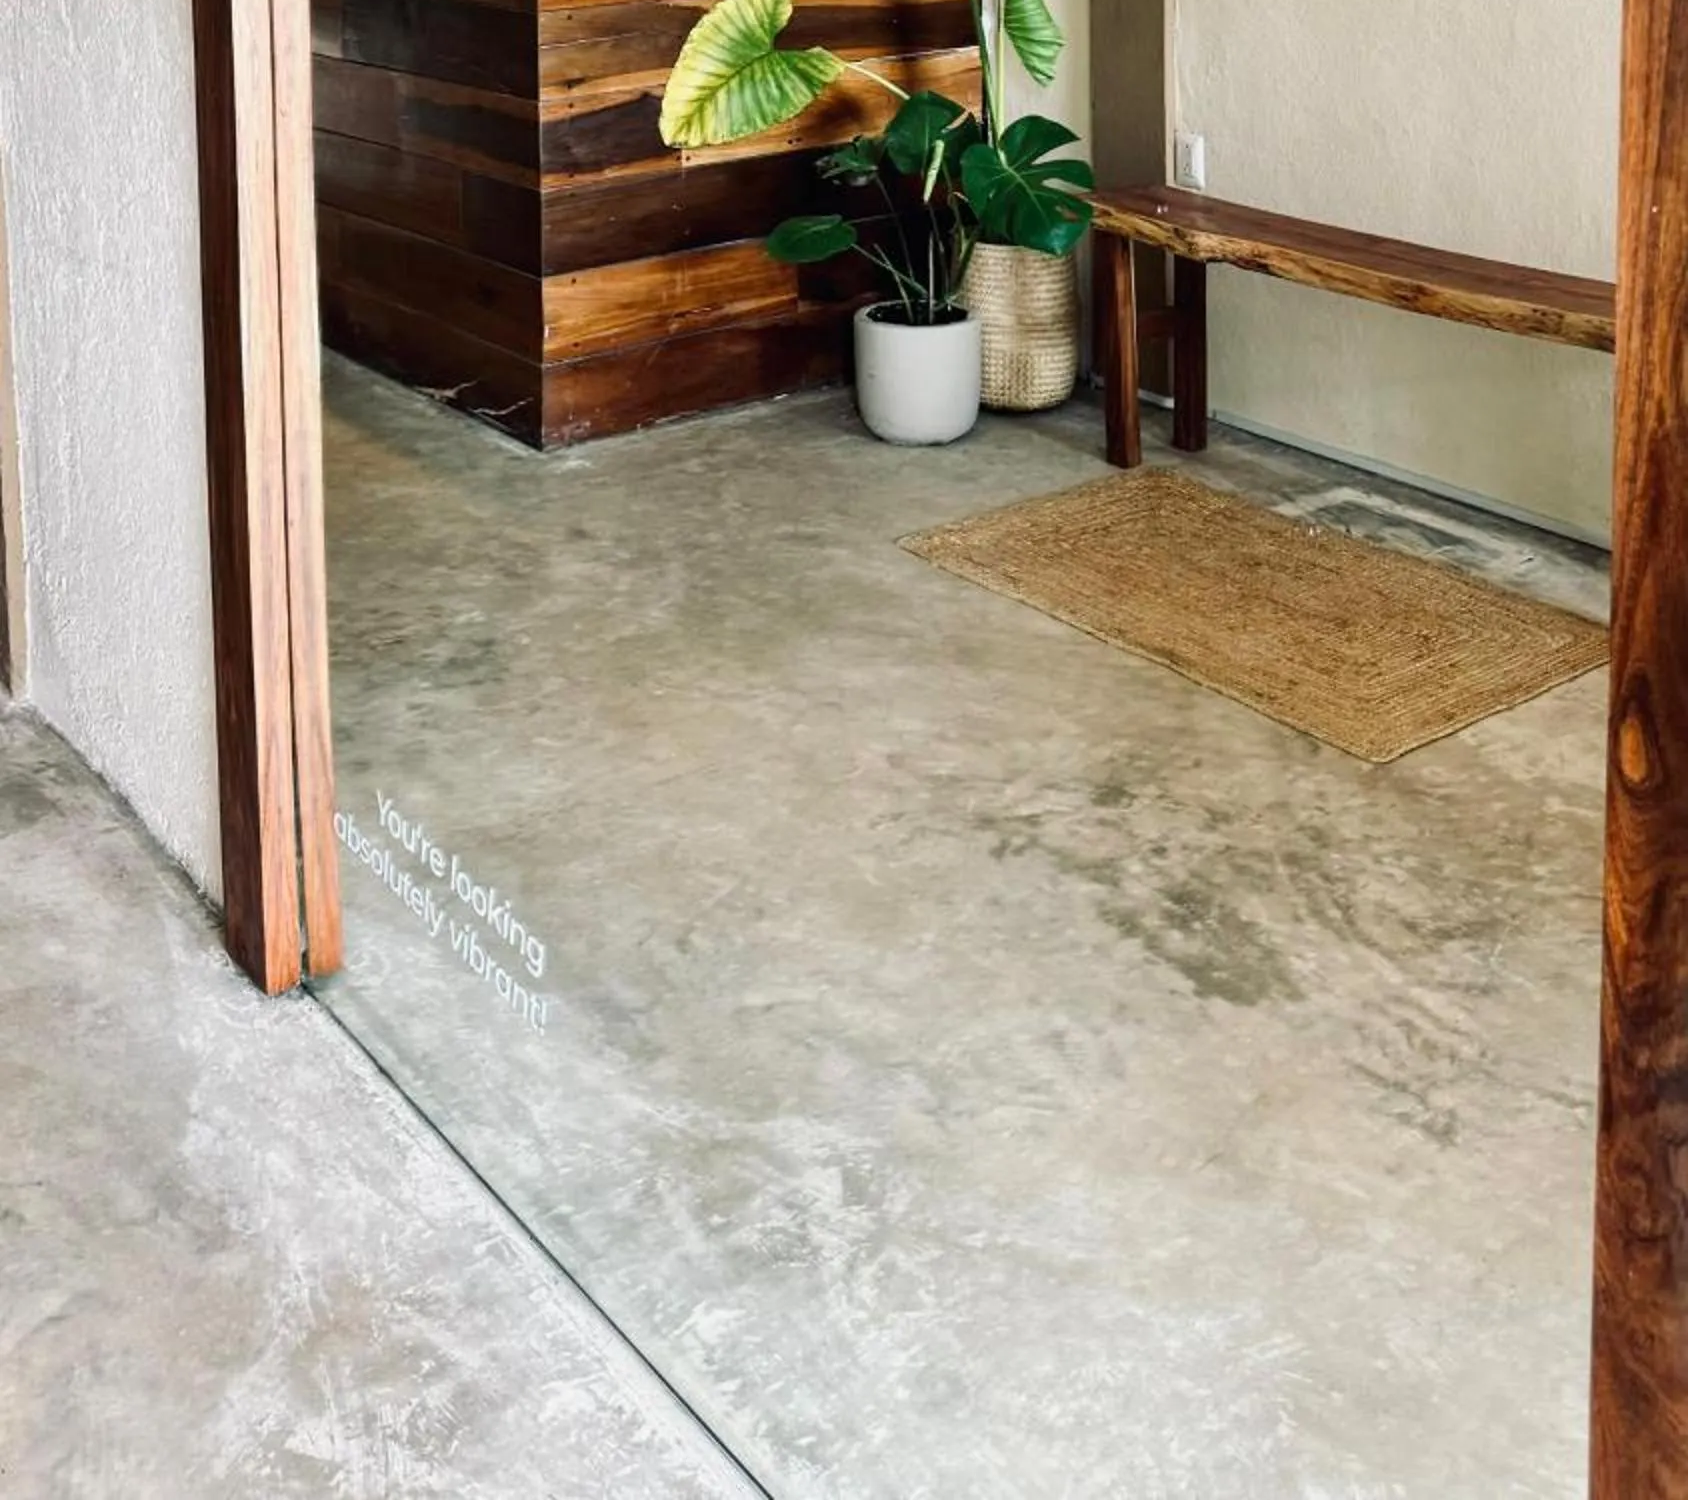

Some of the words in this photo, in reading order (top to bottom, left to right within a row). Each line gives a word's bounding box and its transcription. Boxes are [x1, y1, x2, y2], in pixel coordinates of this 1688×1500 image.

[333, 812, 444, 937] absolutely
[449, 920, 548, 1036] vibrant!
[376, 789, 446, 877] You're
[450, 855, 545, 977] looking
